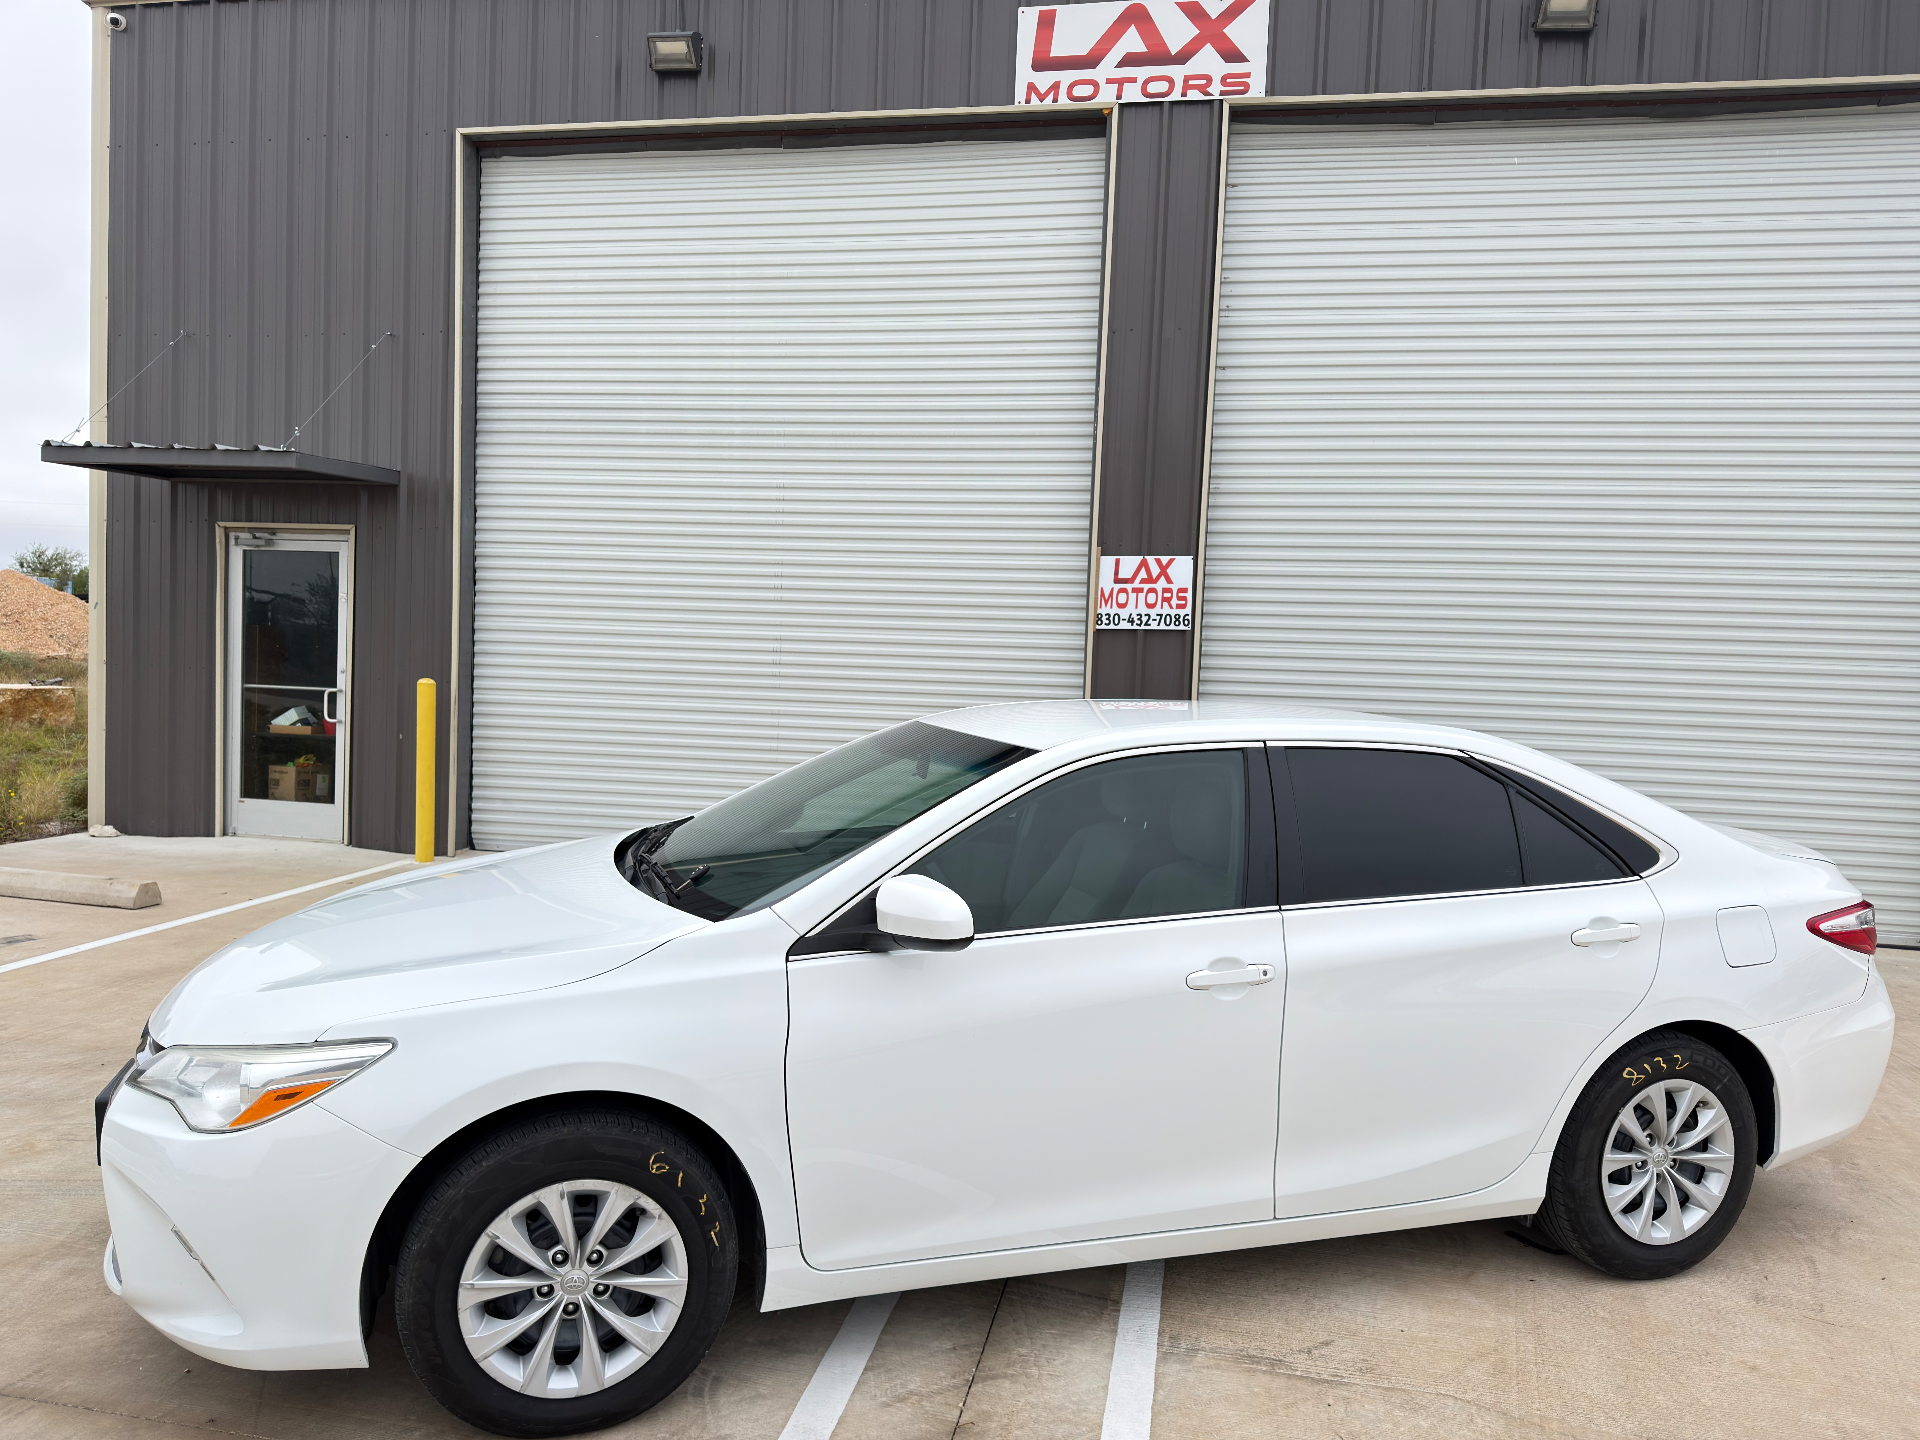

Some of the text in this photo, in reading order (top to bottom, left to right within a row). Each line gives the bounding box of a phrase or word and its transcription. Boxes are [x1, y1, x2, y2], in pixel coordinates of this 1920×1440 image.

[1031, 0, 1256, 72] LAX
[1024, 72, 1252, 104] MOTORS
[1113, 558, 1176, 584] LAX
[1099, 587, 1188, 609] MOTORS
[1096, 613, 1190, 627] 830-432-7086
